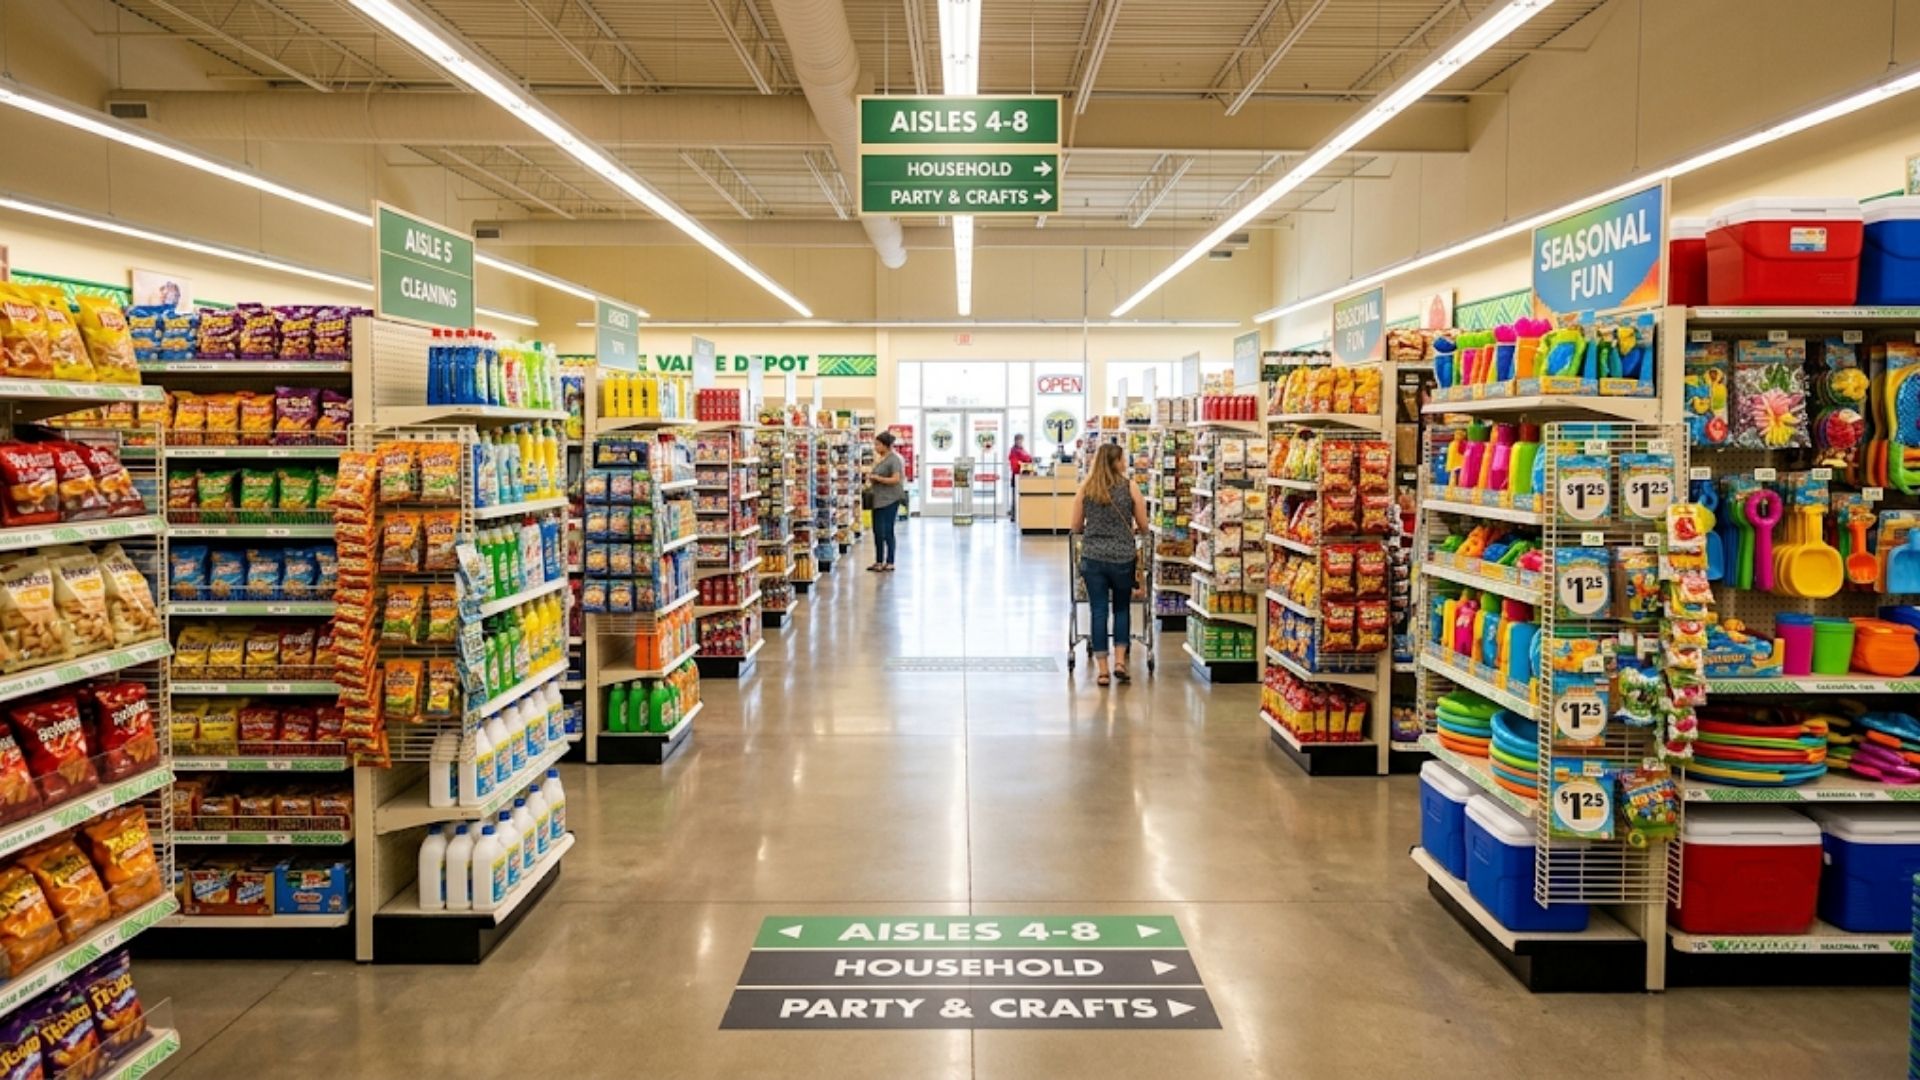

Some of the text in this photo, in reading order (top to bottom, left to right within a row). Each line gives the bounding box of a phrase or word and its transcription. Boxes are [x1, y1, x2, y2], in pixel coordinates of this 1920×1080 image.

[889, 110, 1029, 133] AISLES 4-8
[907, 161, 1012, 177] HOUSEHOLD
[891, 189, 1029, 205] PARTY & CRAFTS
[404, 228, 452, 264] AISLE 5
[1541, 208, 1651, 272] SEASONAL
[1571, 260, 1613, 302] FUN
[400, 275, 457, 308] CLEANING
[656, 355, 726, 372] VALE
[735, 355, 809, 372] DPOT
[1038, 376, 1082, 393] OPEN
[837, 922, 1100, 942] AISLES 4-8
[833, 958, 1104, 977] HOUSEHOLD
[779, 998, 1159, 1019] PARTY & CRAFTS
